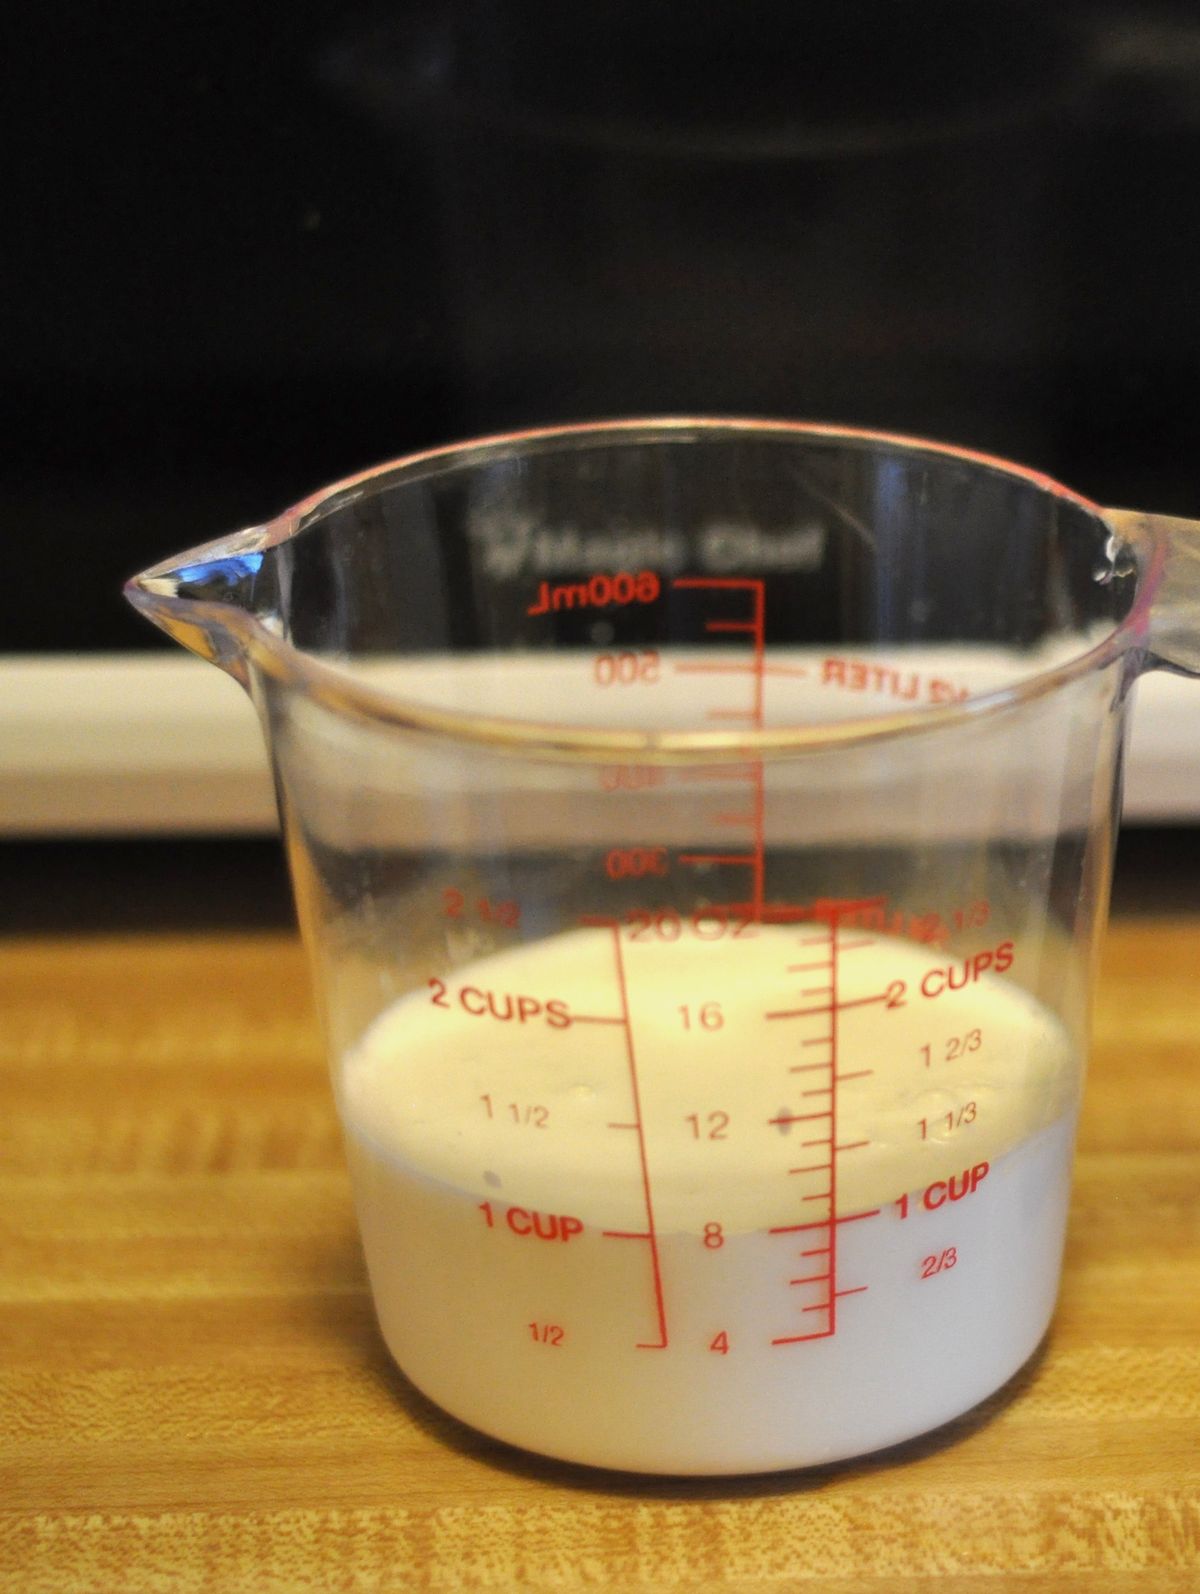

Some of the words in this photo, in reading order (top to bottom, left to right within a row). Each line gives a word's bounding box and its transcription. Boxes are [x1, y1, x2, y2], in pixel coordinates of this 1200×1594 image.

[887, 979, 907, 1009] 2
[921, 941, 1014, 999] CUPS
[428, 977, 450, 1008] 2
[459, 986, 572, 1030] CUPS
[678, 1001, 725, 1032] 16
[920, 1043, 931, 1068] 1
[945, 1028, 982, 1062] 2/3
[480, 1094, 494, 1119] 1
[509, 1103, 550, 1129] 1/2
[685, 1110, 730, 1140] 12
[917, 1118, 927, 1140] 1
[945, 1101, 977, 1131] 1/3
[895, 1193, 908, 1220] 1
[923, 1161, 990, 1211] CUP
[479, 1201, 494, 1228] 1
[506, 1206, 584, 1242] CUP
[703, 1221, 724, 1250] 8
[921, 1247, 957, 1280] 2/3
[528, 1322, 564, 1347] 1/2
[709, 1330, 730, 1355] 4
